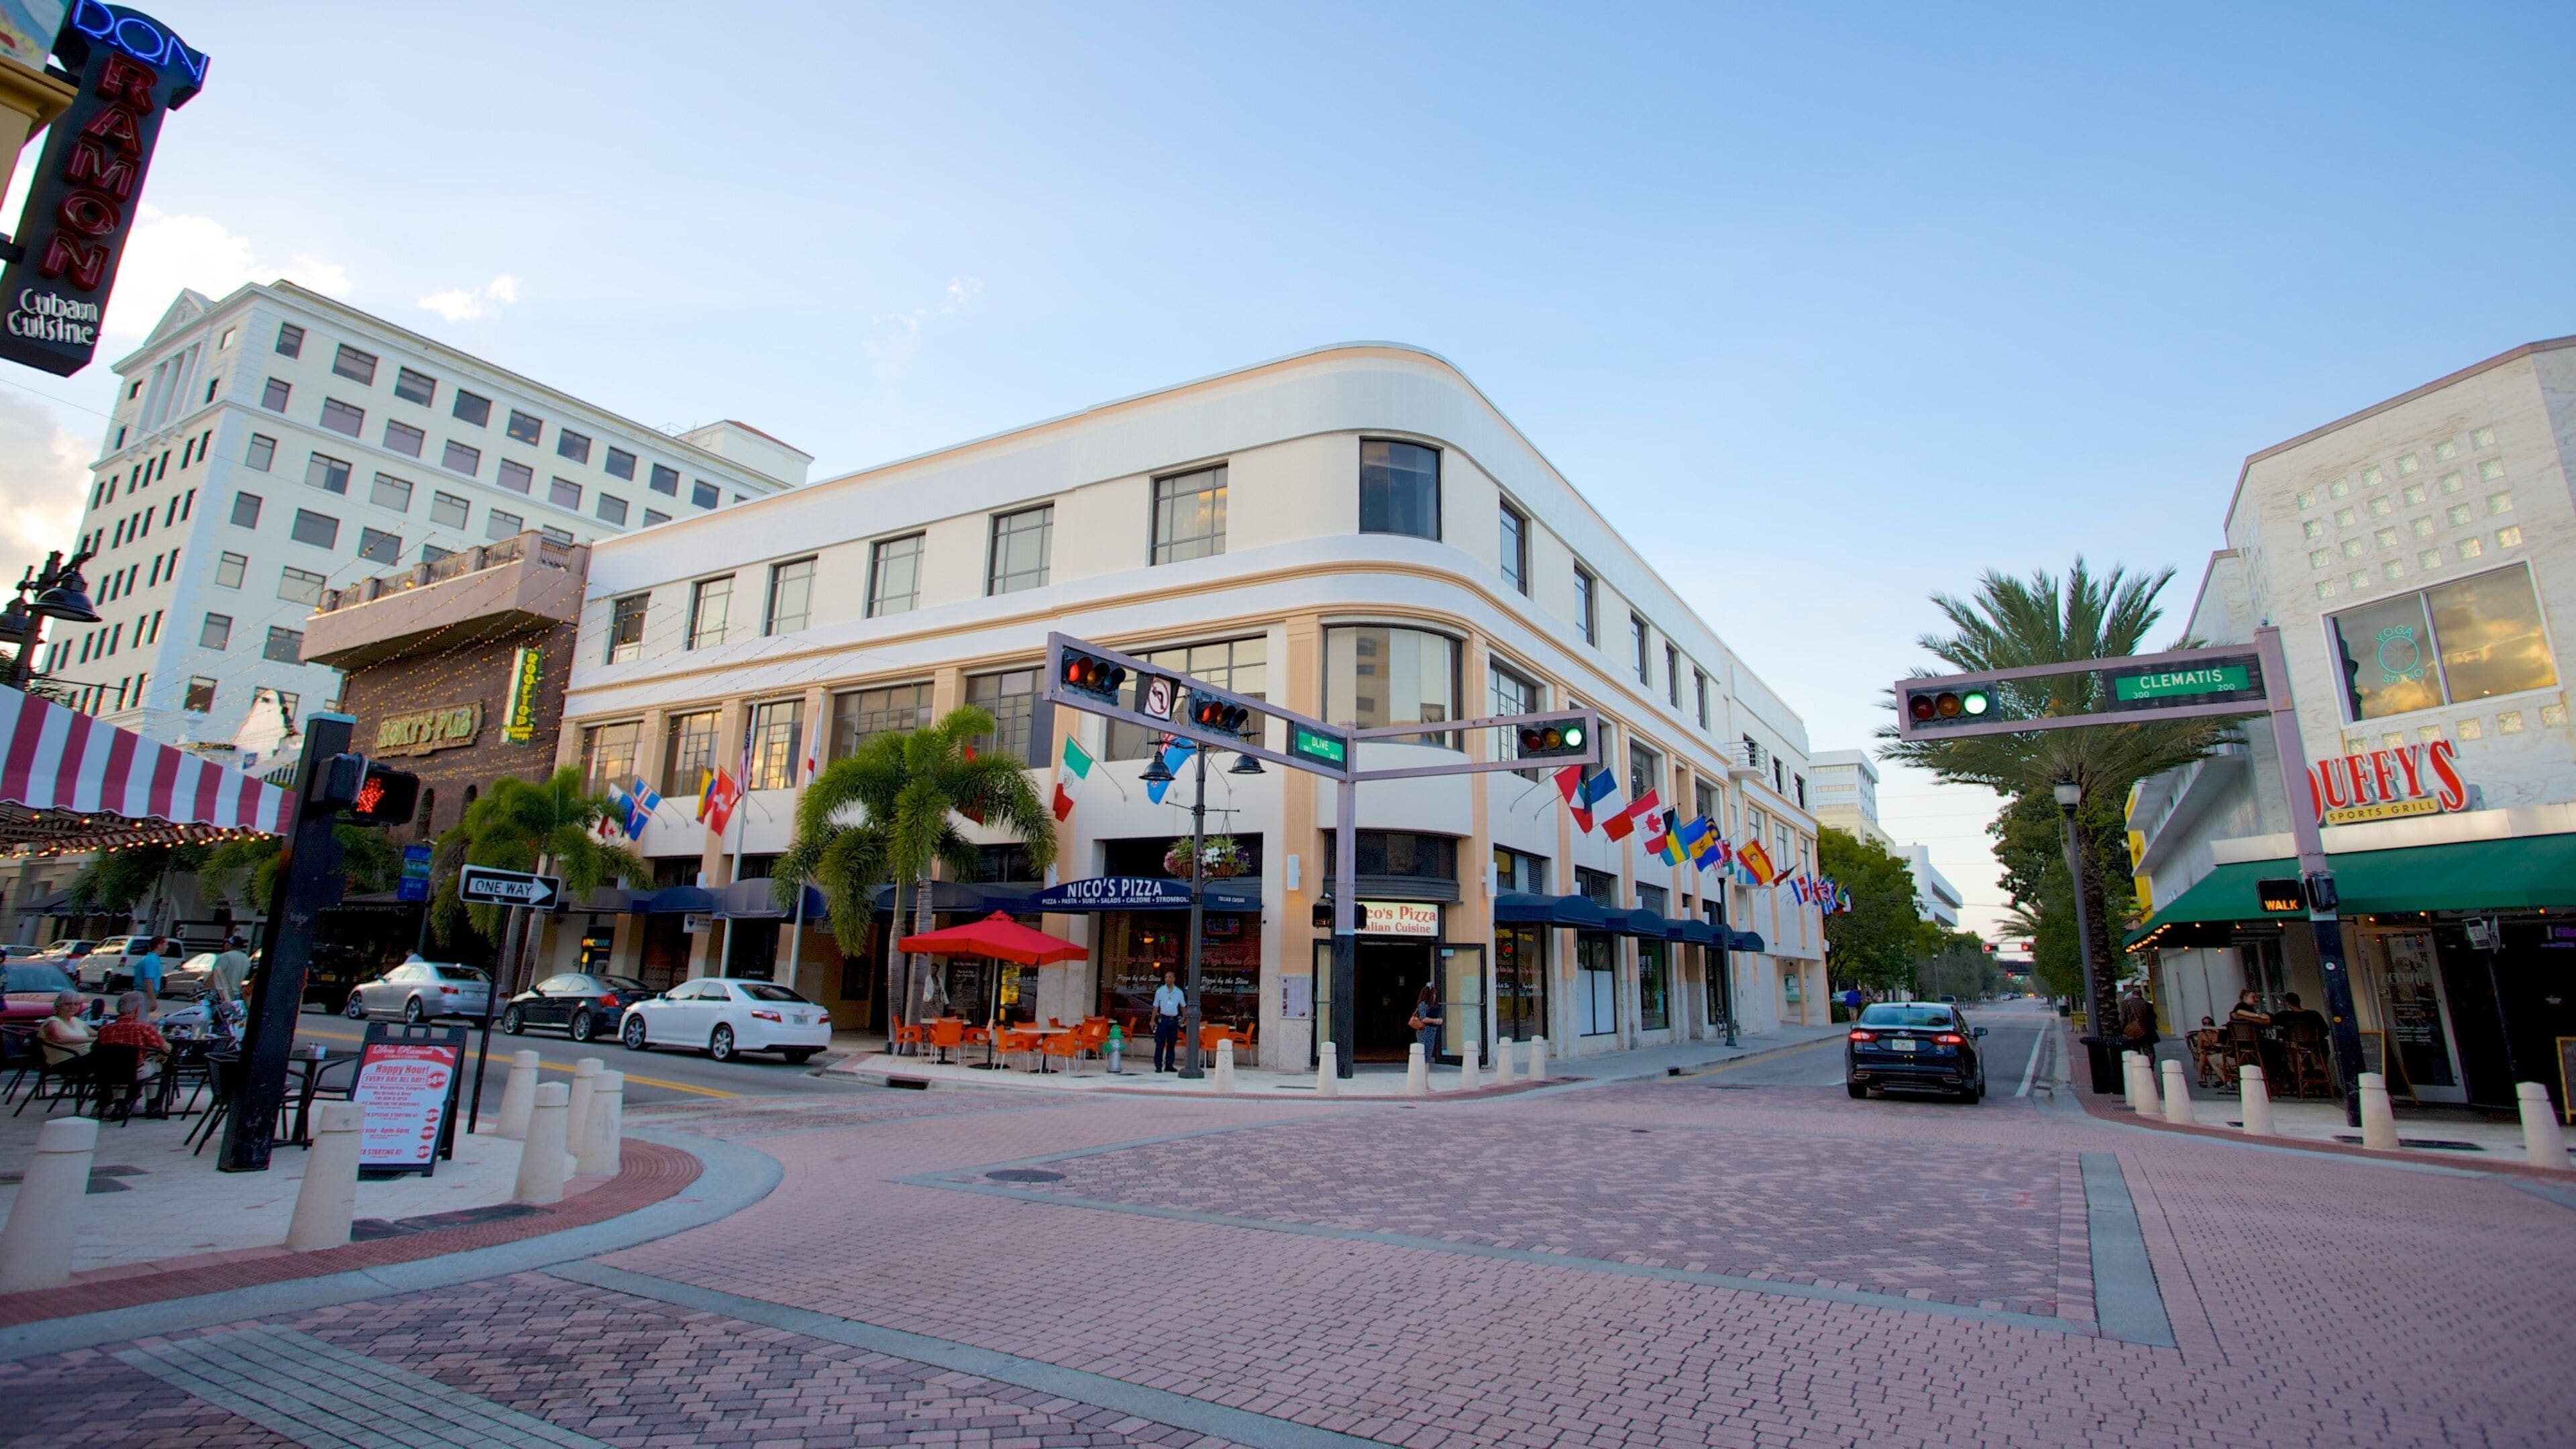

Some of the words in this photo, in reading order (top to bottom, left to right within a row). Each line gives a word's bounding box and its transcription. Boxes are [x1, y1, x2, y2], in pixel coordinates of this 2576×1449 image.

[73, 0, 207, 82] DON
[40, 52, 158, 292] RAMON
[19, 288, 98, 323] Cuban
[6, 308, 96, 345] Cuisine
[2375, 625, 2413, 643] YOGA
[2140, 669, 2223, 689] CLEMATIS
[2382, 667, 2424, 684] STUDIO
[515, 653, 539, 725] ROOFTOP
[2133, 691, 2150, 699] 300
[2218, 683, 2235, 692] 200
[434, 708, 473, 740] PUB
[1311, 737, 1329, 751] OLIVE
[2329, 808, 2382, 822] SPORTS
[2391, 802, 2434, 814] GRILL
[474, 879, 502, 894] ONE
[506, 881, 533, 896] WAY
[1067, 878, 1116, 898] NICO'S
[1122, 879, 1163, 897] PIZZA
[2264, 899, 2298, 911] WALK
[1366, 907, 1393, 920] co's
[1399, 906, 1436, 922] Pizza
[1365, 922, 1391, 932] alian
[1395, 922, 1431, 934] Cuisine
[1218, 977, 1224, 985] by
[376, 1064, 402, 1075] Happy
[406, 1065, 429, 1075] Hour!
